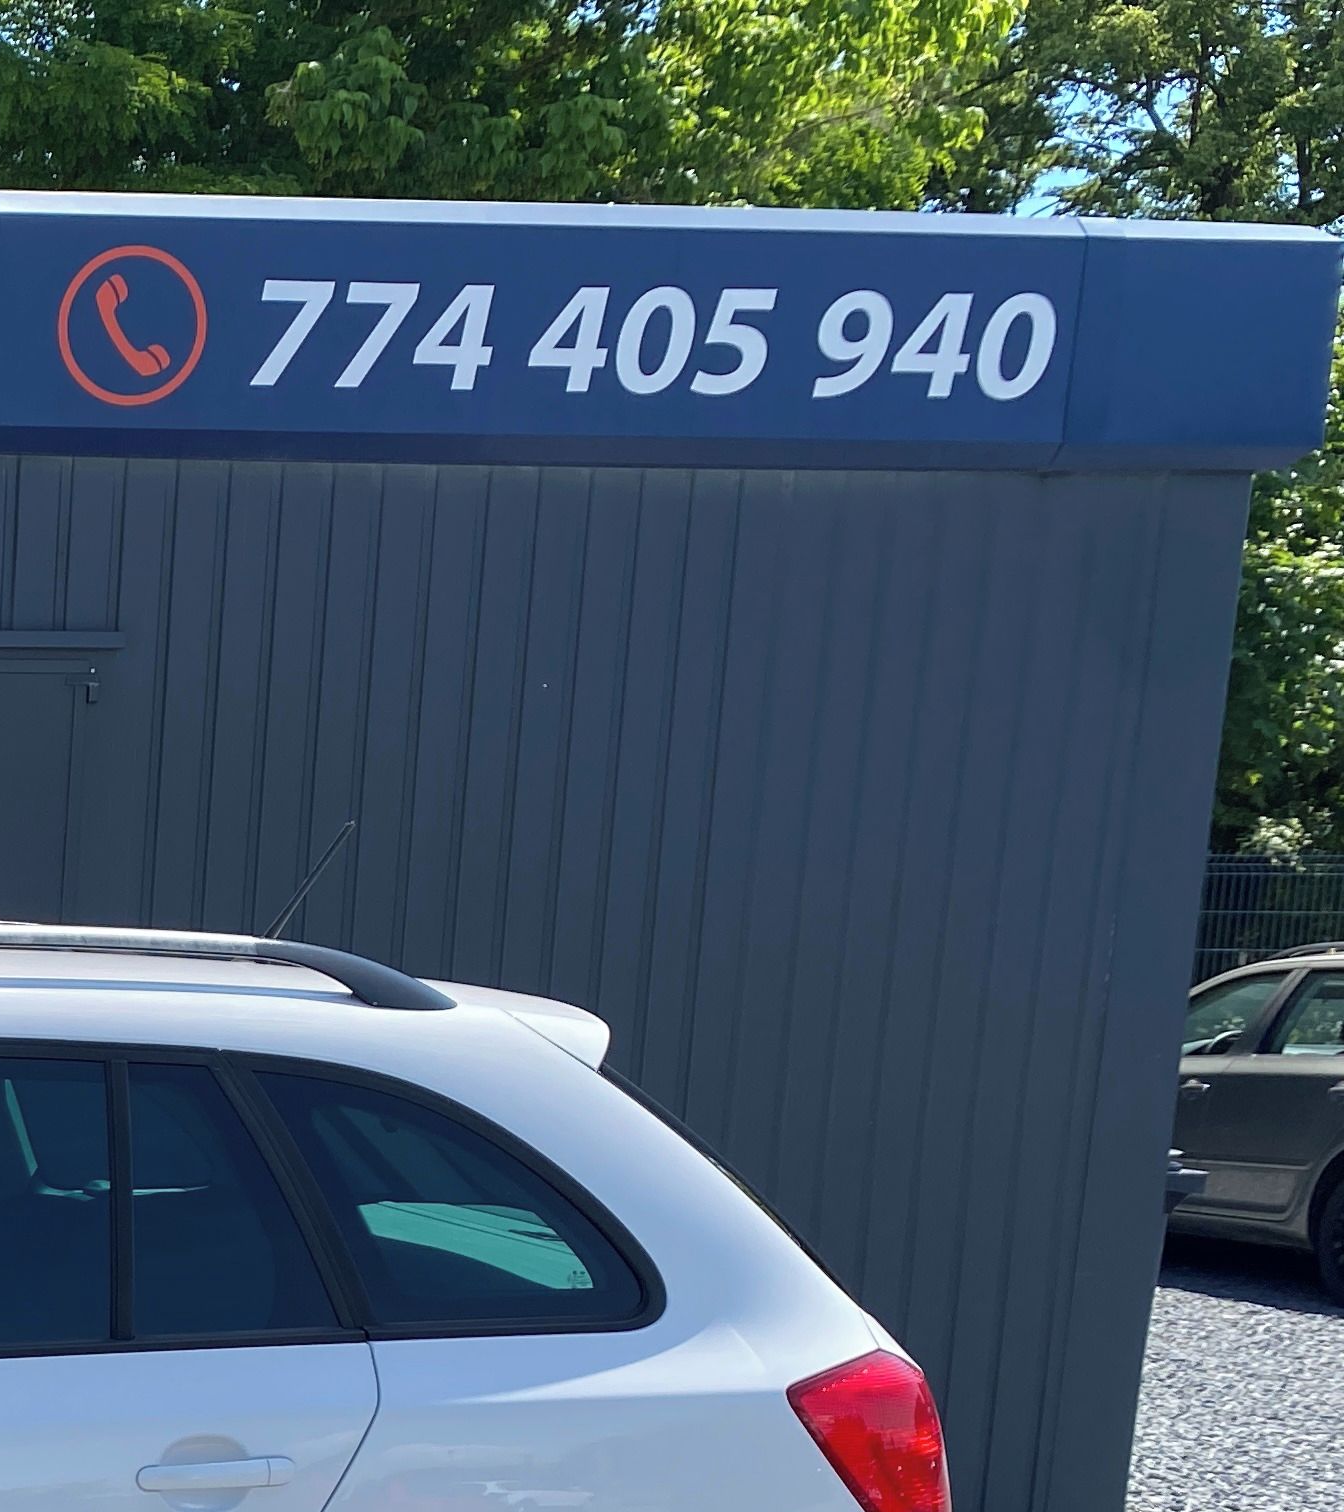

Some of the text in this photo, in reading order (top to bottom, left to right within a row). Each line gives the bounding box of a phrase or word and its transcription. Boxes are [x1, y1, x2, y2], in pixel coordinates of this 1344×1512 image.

[250, 279, 1055, 399] 774 405 940
